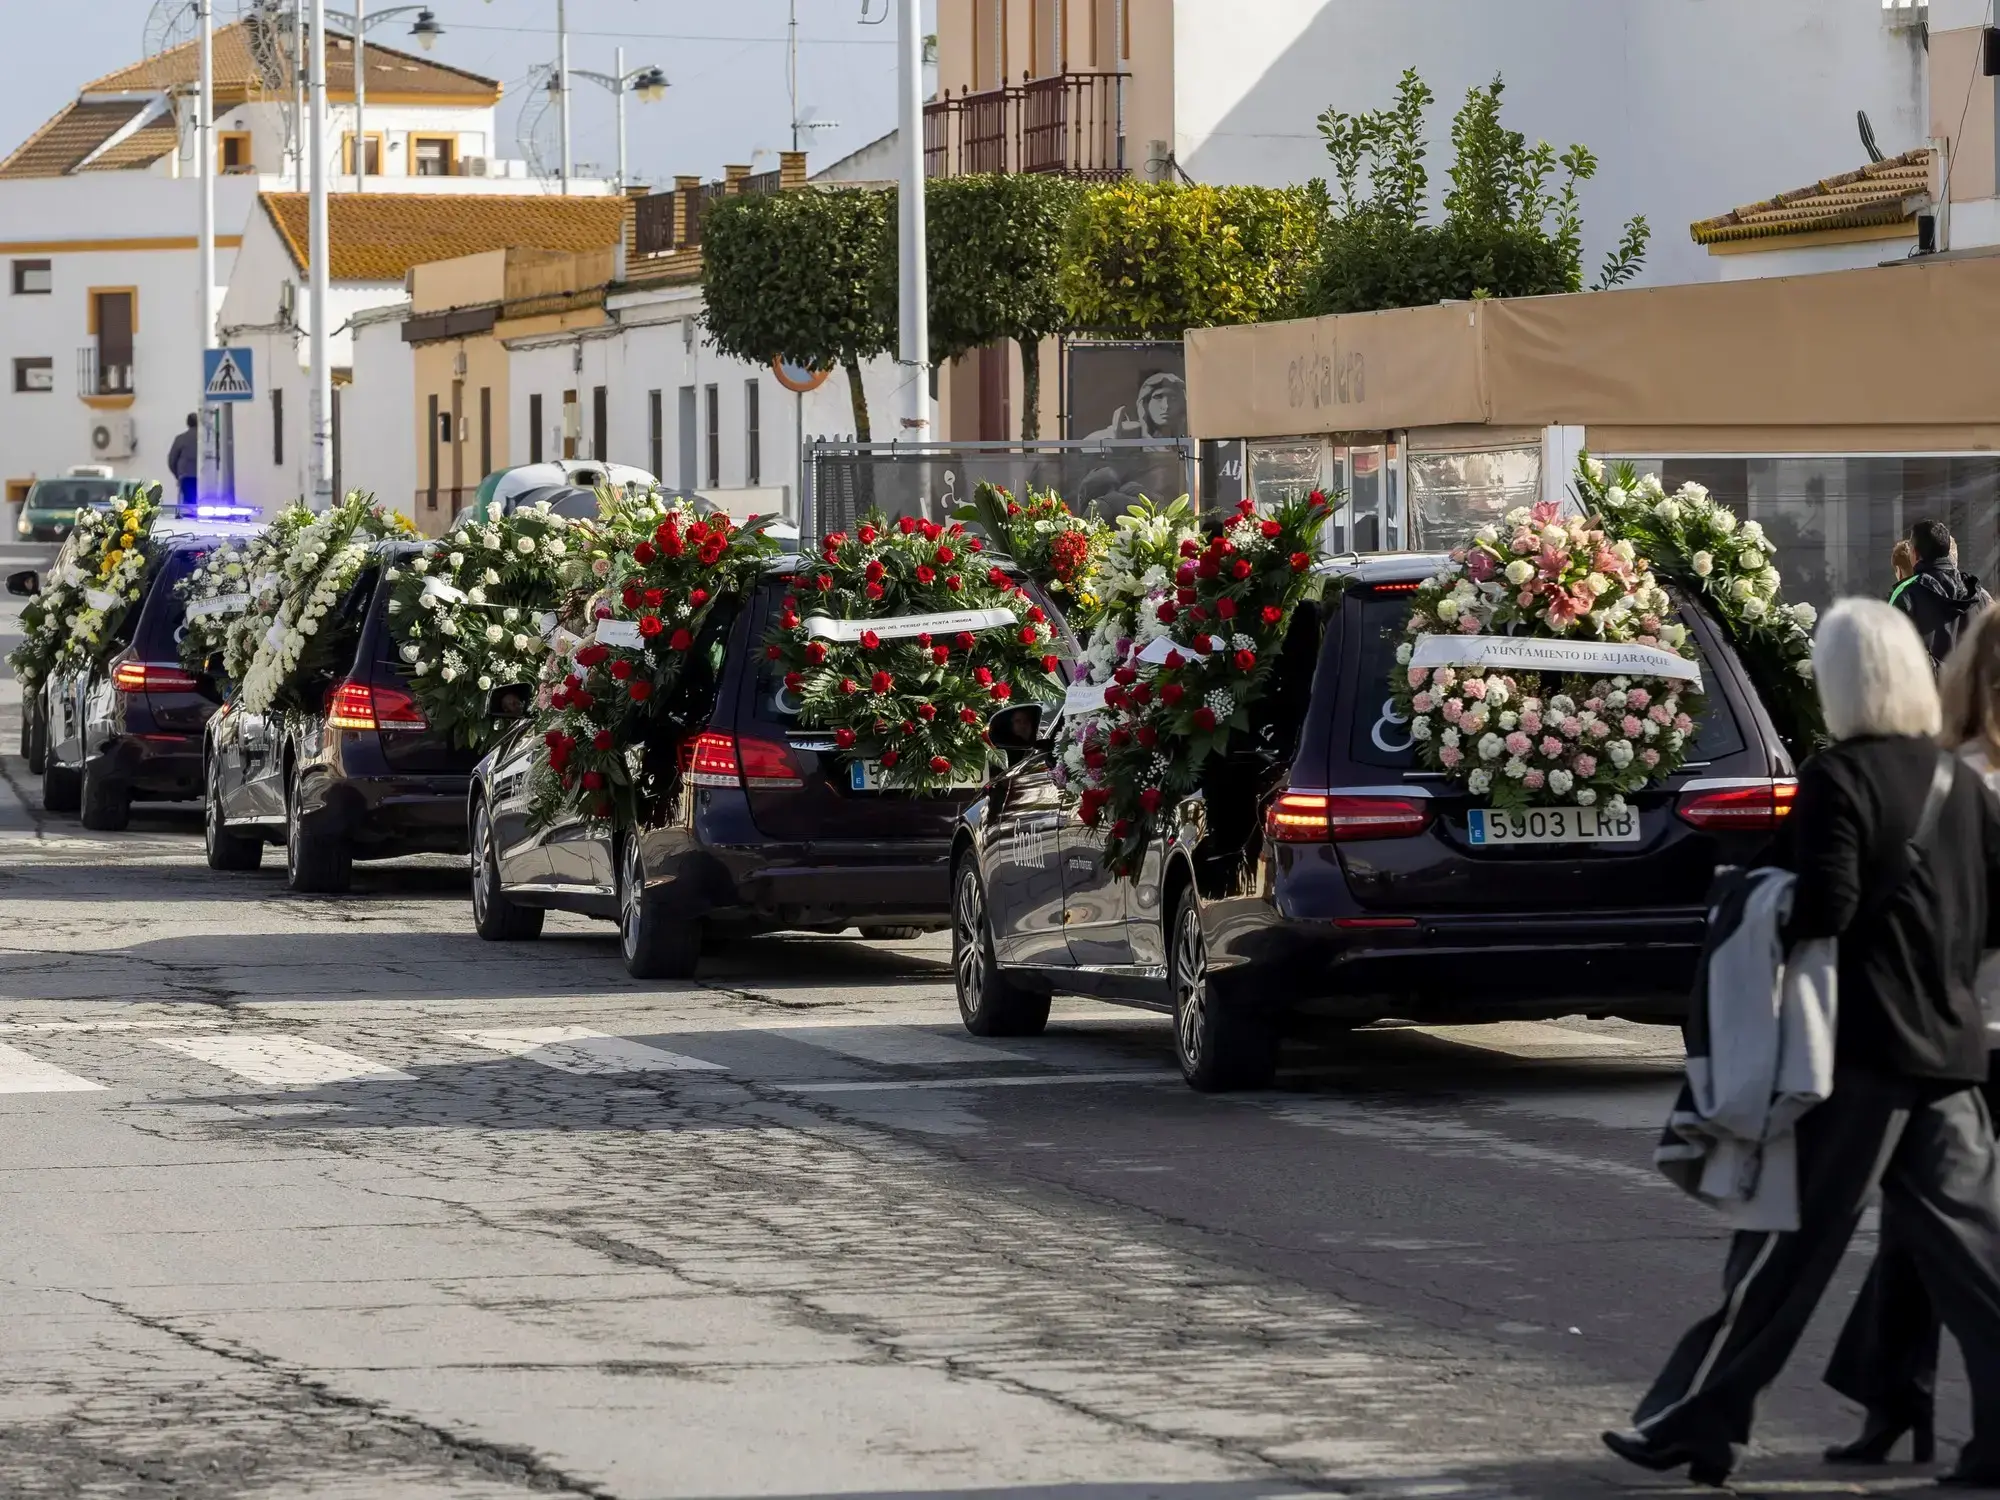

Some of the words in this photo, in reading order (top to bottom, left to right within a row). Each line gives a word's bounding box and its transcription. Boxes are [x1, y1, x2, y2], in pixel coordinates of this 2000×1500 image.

[1483, 644, 1580, 661] AYUNTAMIENTO
[1583, 650, 1600, 661] DE
[1601, 651, 1671, 667] ALJARAQUE
[1475, 829, 1483, 838] E
[1490, 811, 1566, 839] 5903
[1576, 811, 1632, 837] LRB
